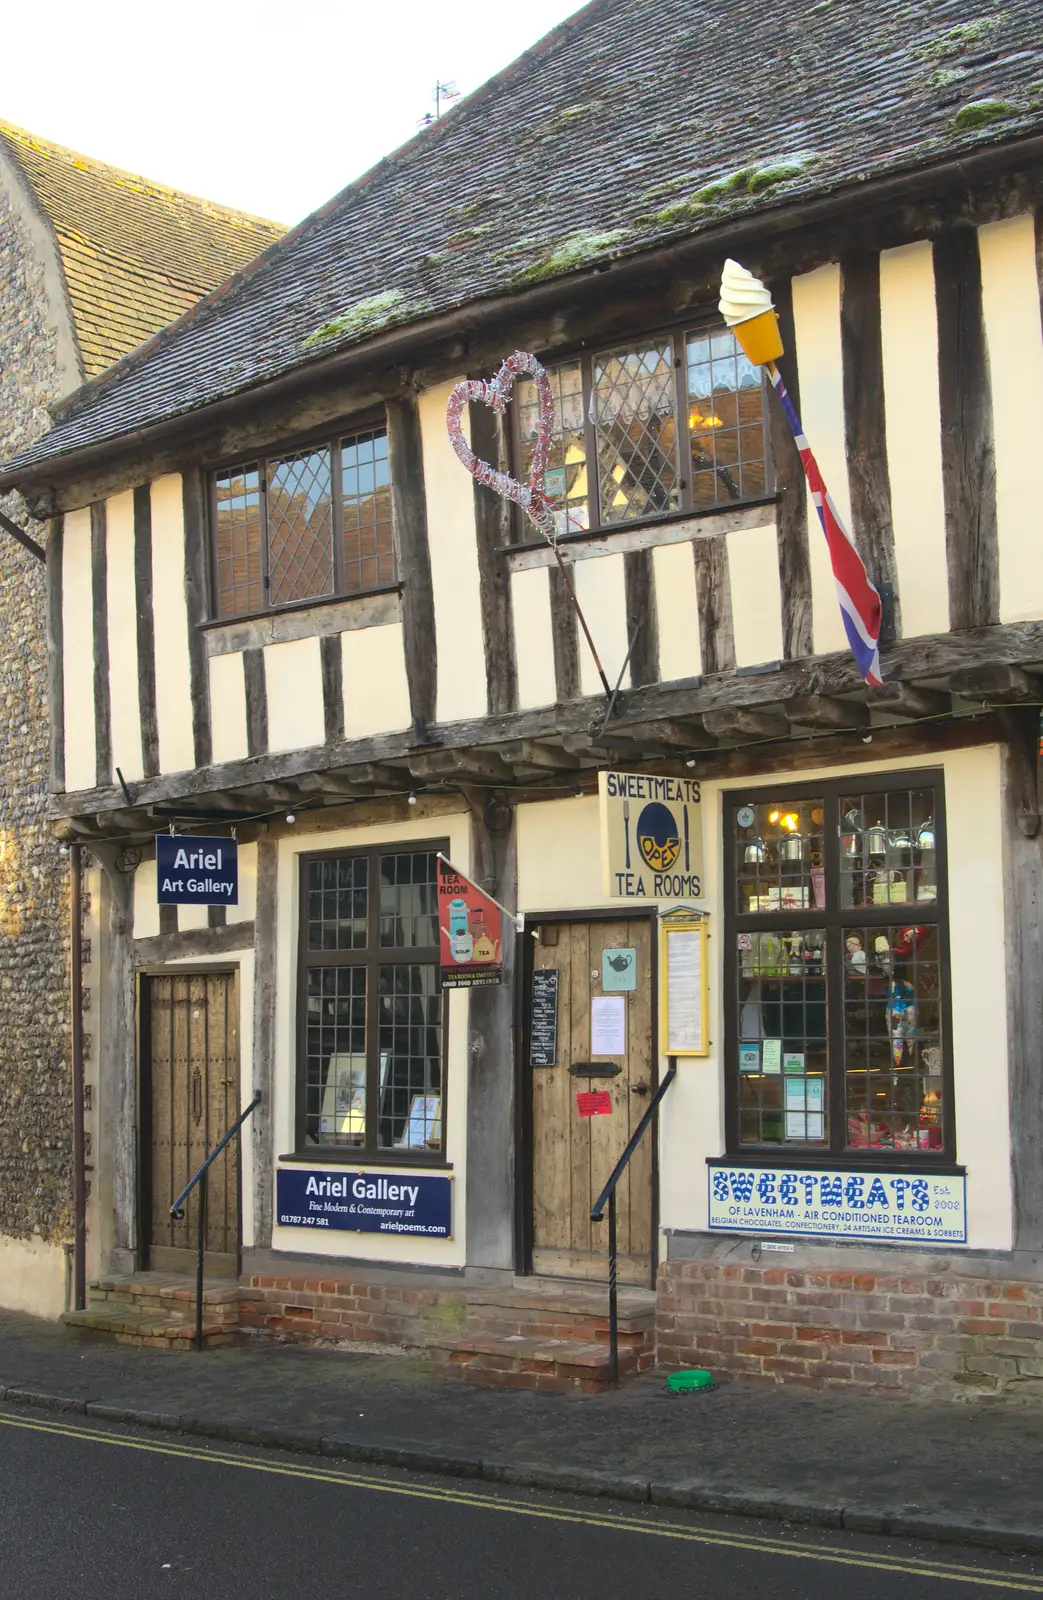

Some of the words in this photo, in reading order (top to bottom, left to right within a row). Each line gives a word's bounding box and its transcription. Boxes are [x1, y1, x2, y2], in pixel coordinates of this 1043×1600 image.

[607, 773, 701, 803] SWEETMEATS
[173, 848, 222, 870] Ariel
[642, 837, 680, 869] OPEN
[162, 878, 184, 892] Art
[187, 878, 234, 896] Gallery
[440, 886, 468, 895] ROOM
[441, 875, 460, 885] TEA
[615, 873, 646, 896] TEA
[654, 874, 701, 897] ROOMS
[305, 1176, 348, 1198] Ariel
[352, 1178, 420, 1206] Gallery
[713, 1171, 930, 1212] SWEETMEATS
[309, 1200, 323, 1211] Fine
[323, 1201, 348, 1213] Modern
[349, 1204, 356, 1213] &
[357, 1204, 404, 1218] Contemporary
[404, 1208, 416, 1217] art
[934, 1200, 961, 1211] 2002
[281, 1214, 301, 1224] 01787
[302, 1216, 316, 1225] 247
[316, 1217, 330, 1226] 581
[711, 1216, 738, 1225] BELGIAN
[853, 1224, 881, 1233] ARTISAN
[883, 1226, 894, 1234] ICE
[896, 1227, 925, 1236] CREAMS
[934, 1229, 964, 1238] SORBETS
[728, 1206, 741, 1216] OF
[743, 1207, 795, 1219] LAVENHAM
[804, 1210, 819, 1220] AIR
[821, 1211, 890, 1224] CONDITIONED
[893, 1215, 943, 1227] TEAROOM
[380, 1221, 446, 1234] arielpoems.com
